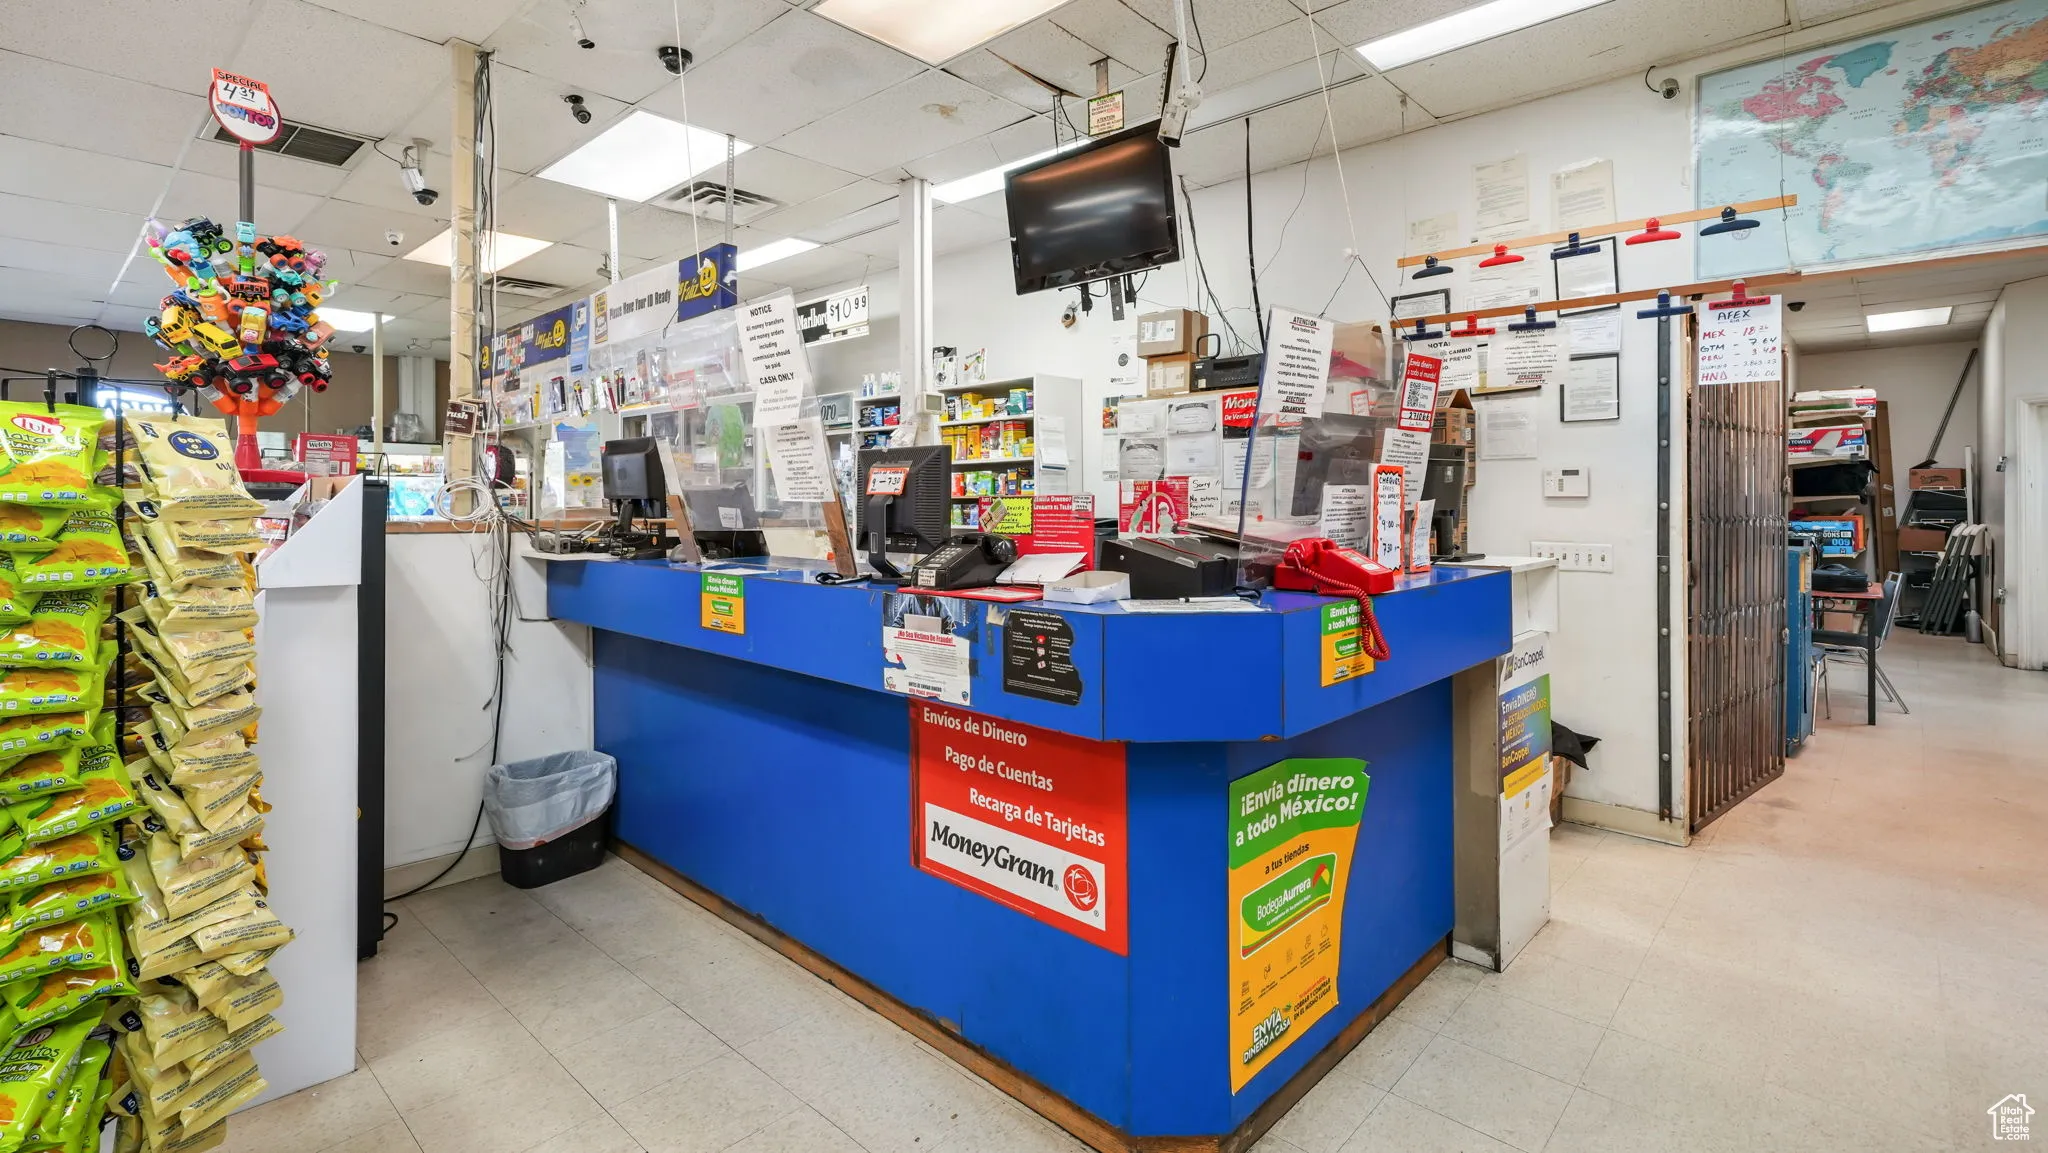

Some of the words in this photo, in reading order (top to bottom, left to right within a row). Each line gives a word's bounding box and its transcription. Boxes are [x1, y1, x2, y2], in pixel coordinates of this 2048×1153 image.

[218, 71, 264, 91] SPECIAL
[623, 301, 634, 316] Have
[635, 296, 647, 310] Your
[655, 287, 671, 304] Ready
[750, 304, 772, 318] NOTICE
[1717, 309, 1751, 321] AFEX
[764, 318, 784, 327] transfers
[770, 329, 784, 337] orders
[1703, 329, 1726, 340] MEX
[1743, 327, 1756, 337] 18
[759, 341, 778, 350] including
[1449, 347, 1472, 355] CAMBIO
[1700, 344, 1725, 352] GTM
[775, 349, 791, 357] should
[759, 375, 777, 385] CASH
[777, 372, 794, 381] ONLY
[1701, 370, 1727, 381] HND
[1225, 395, 1257, 410] Mone
[177, 436, 203, 444] bon
[186, 447, 212, 455] bon
[1193, 479, 1211, 488] Sorry
[1332, 620, 1345, 630] todo
[1513, 646, 1545, 671] BanCoppel
[1501, 696, 1517, 715] Envía
[1501, 720, 1508, 730] de
[1508, 706, 1528, 726] ESTADOS
[923, 706, 961, 730] Envíos
[963, 716, 980, 735] de
[982, 721, 1027, 747] Dinero
[1501, 744, 1530, 769] BanCoppel
[945, 745, 976, 772] Pago
[978, 755, 994, 774] de
[997, 761, 1053, 792] Cuentas
[1241, 781, 1284, 818] ¡Envía
[1287, 773, 1355, 795] dinero
[969, 787, 1022, 822] Recarga
[1024, 805, 1042, 826] de
[1044, 811, 1105, 847] Tarjetas
[1235, 830, 1244, 847] a
[1247, 813, 1277, 841] todo
[1280, 792, 1359, 824] México!
[931, 821, 1054, 888] MoneyGram
[1265, 865, 1270, 875] a
[1271, 858, 1283, 871] tus
[1284, 842, 1310, 865] tiendas
[1257, 877, 1312, 921] BodegaAurrera
[126, 1016, 135, 1025] 5
[1253, 1007, 1282, 1043] ENVÍA
[1243, 1035, 1269, 1063] DINERO
[1269, 1031, 1275, 1042] A
[1274, 1018, 1291, 1036] CASA
[127, 1098, 136, 1108] 5
